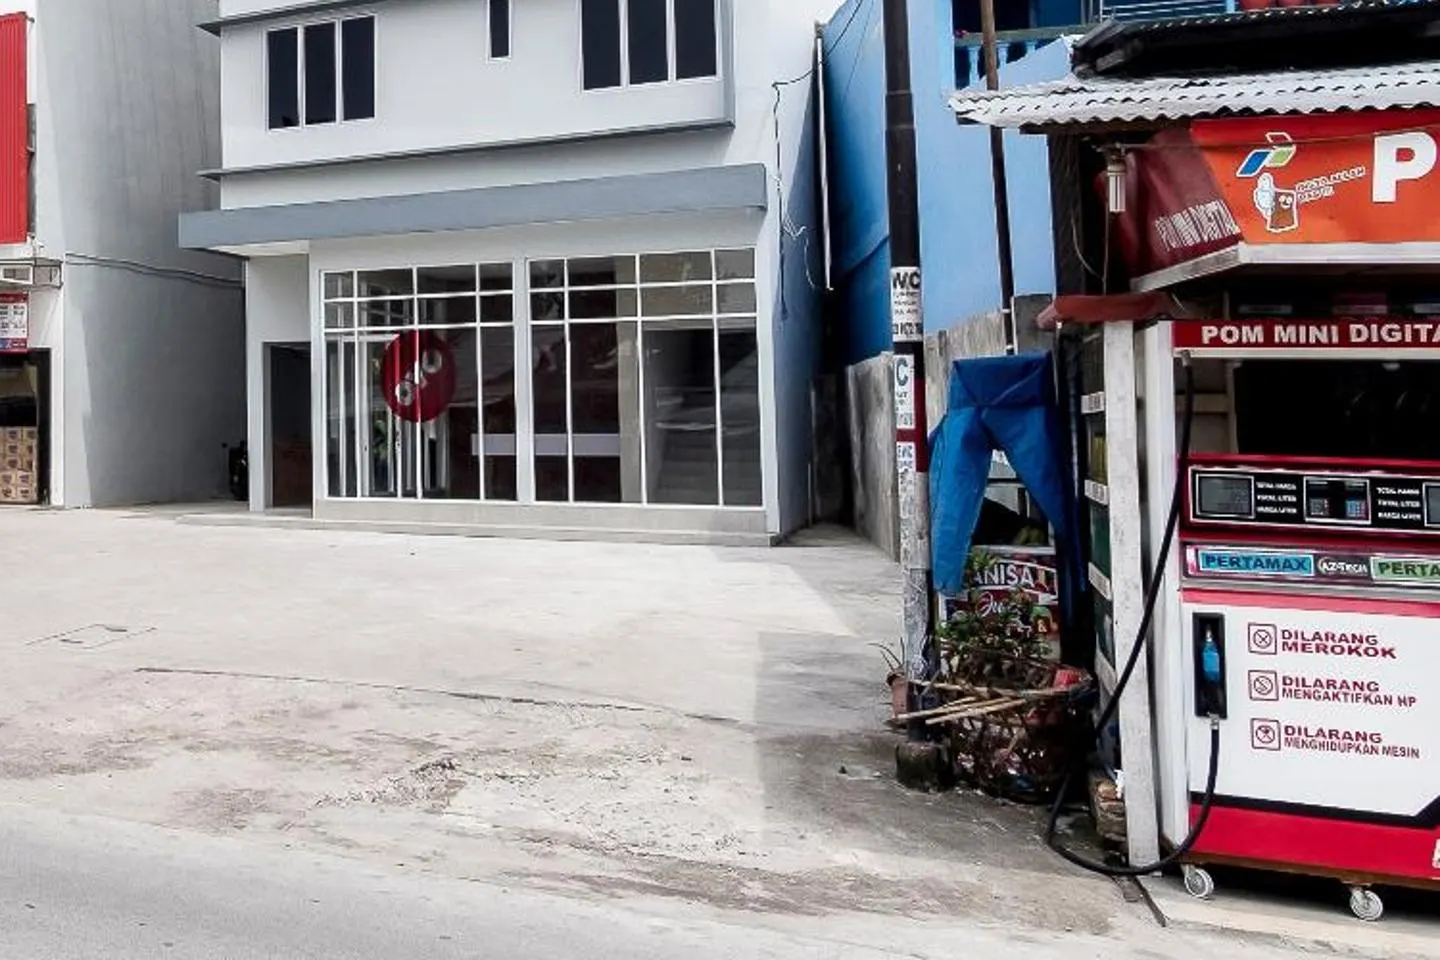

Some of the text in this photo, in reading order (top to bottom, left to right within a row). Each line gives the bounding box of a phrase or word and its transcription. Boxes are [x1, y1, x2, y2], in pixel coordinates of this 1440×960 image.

[1201, 325, 1264, 344] POM
[1274, 324, 1339, 344] MINI
[1205, 555, 1308, 572] PERTAMAX
[1281, 629, 1378, 646] DILARANG
[1281, 641, 1397, 659] MEROKOK
[1282, 675, 1380, 692] DILARANG
[1282, 688, 1417, 707] MENGAKTIFKAN HP
[1284, 725, 1383, 744] DILARANG
[1284, 738, 1420, 759] MENGHIDUPKAN MESIN
